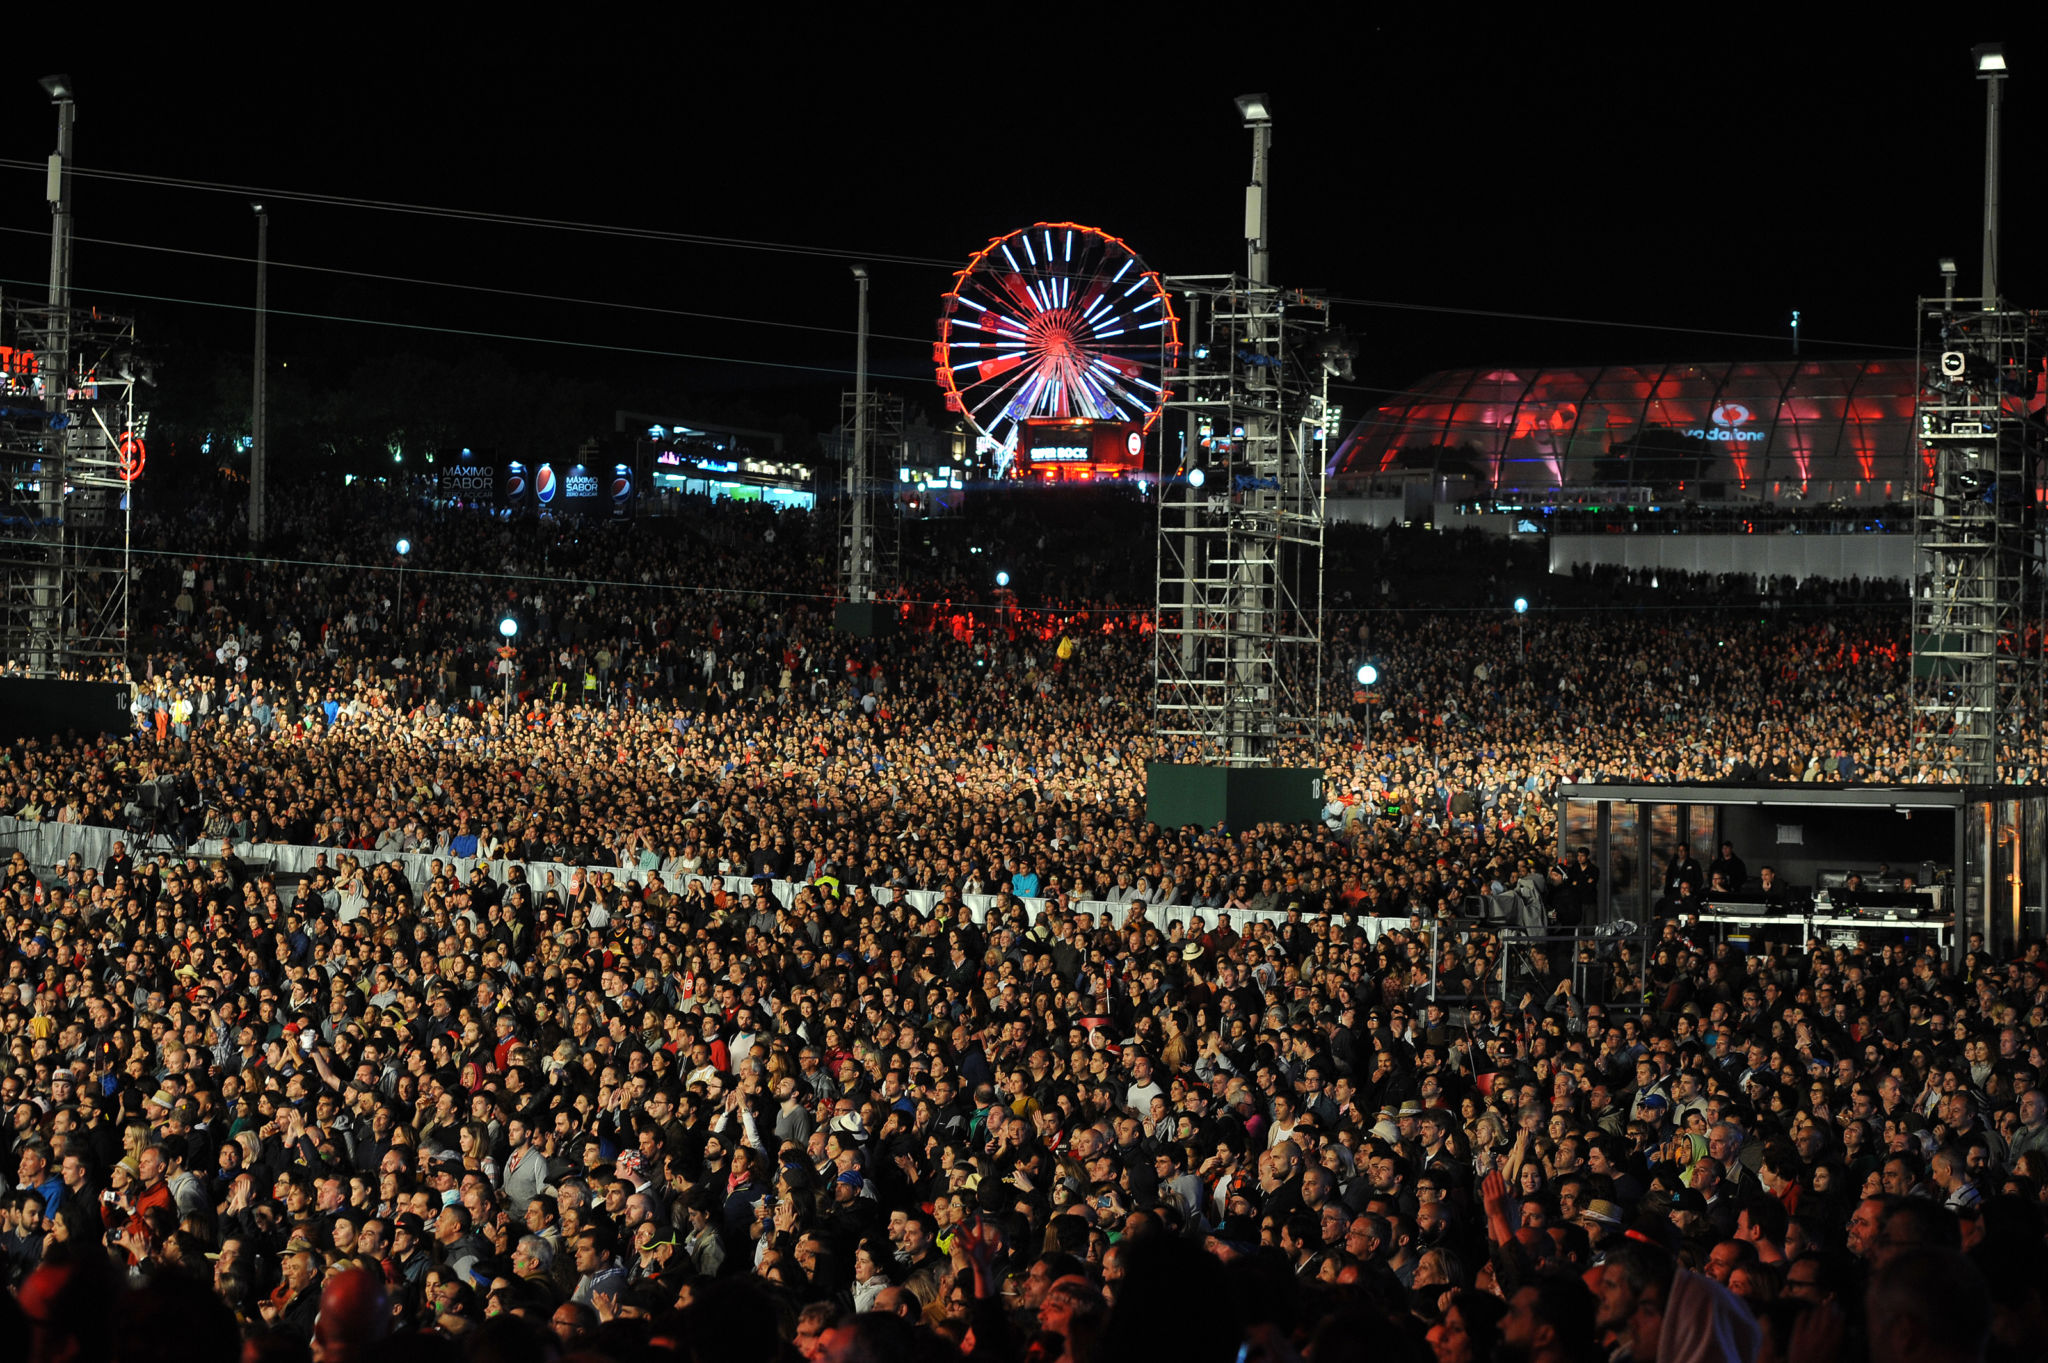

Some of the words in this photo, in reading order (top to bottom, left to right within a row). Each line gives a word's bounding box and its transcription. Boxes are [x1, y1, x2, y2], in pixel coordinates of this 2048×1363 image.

[442, 464, 493, 476] MÁXIMO
[443, 477, 493, 489] SABOR
[566, 475, 598, 484] MÁXIMO
[566, 483, 598, 492] SABOR
[115, 692, 127, 710] 1C
[1312, 778, 1321, 799] 1B
